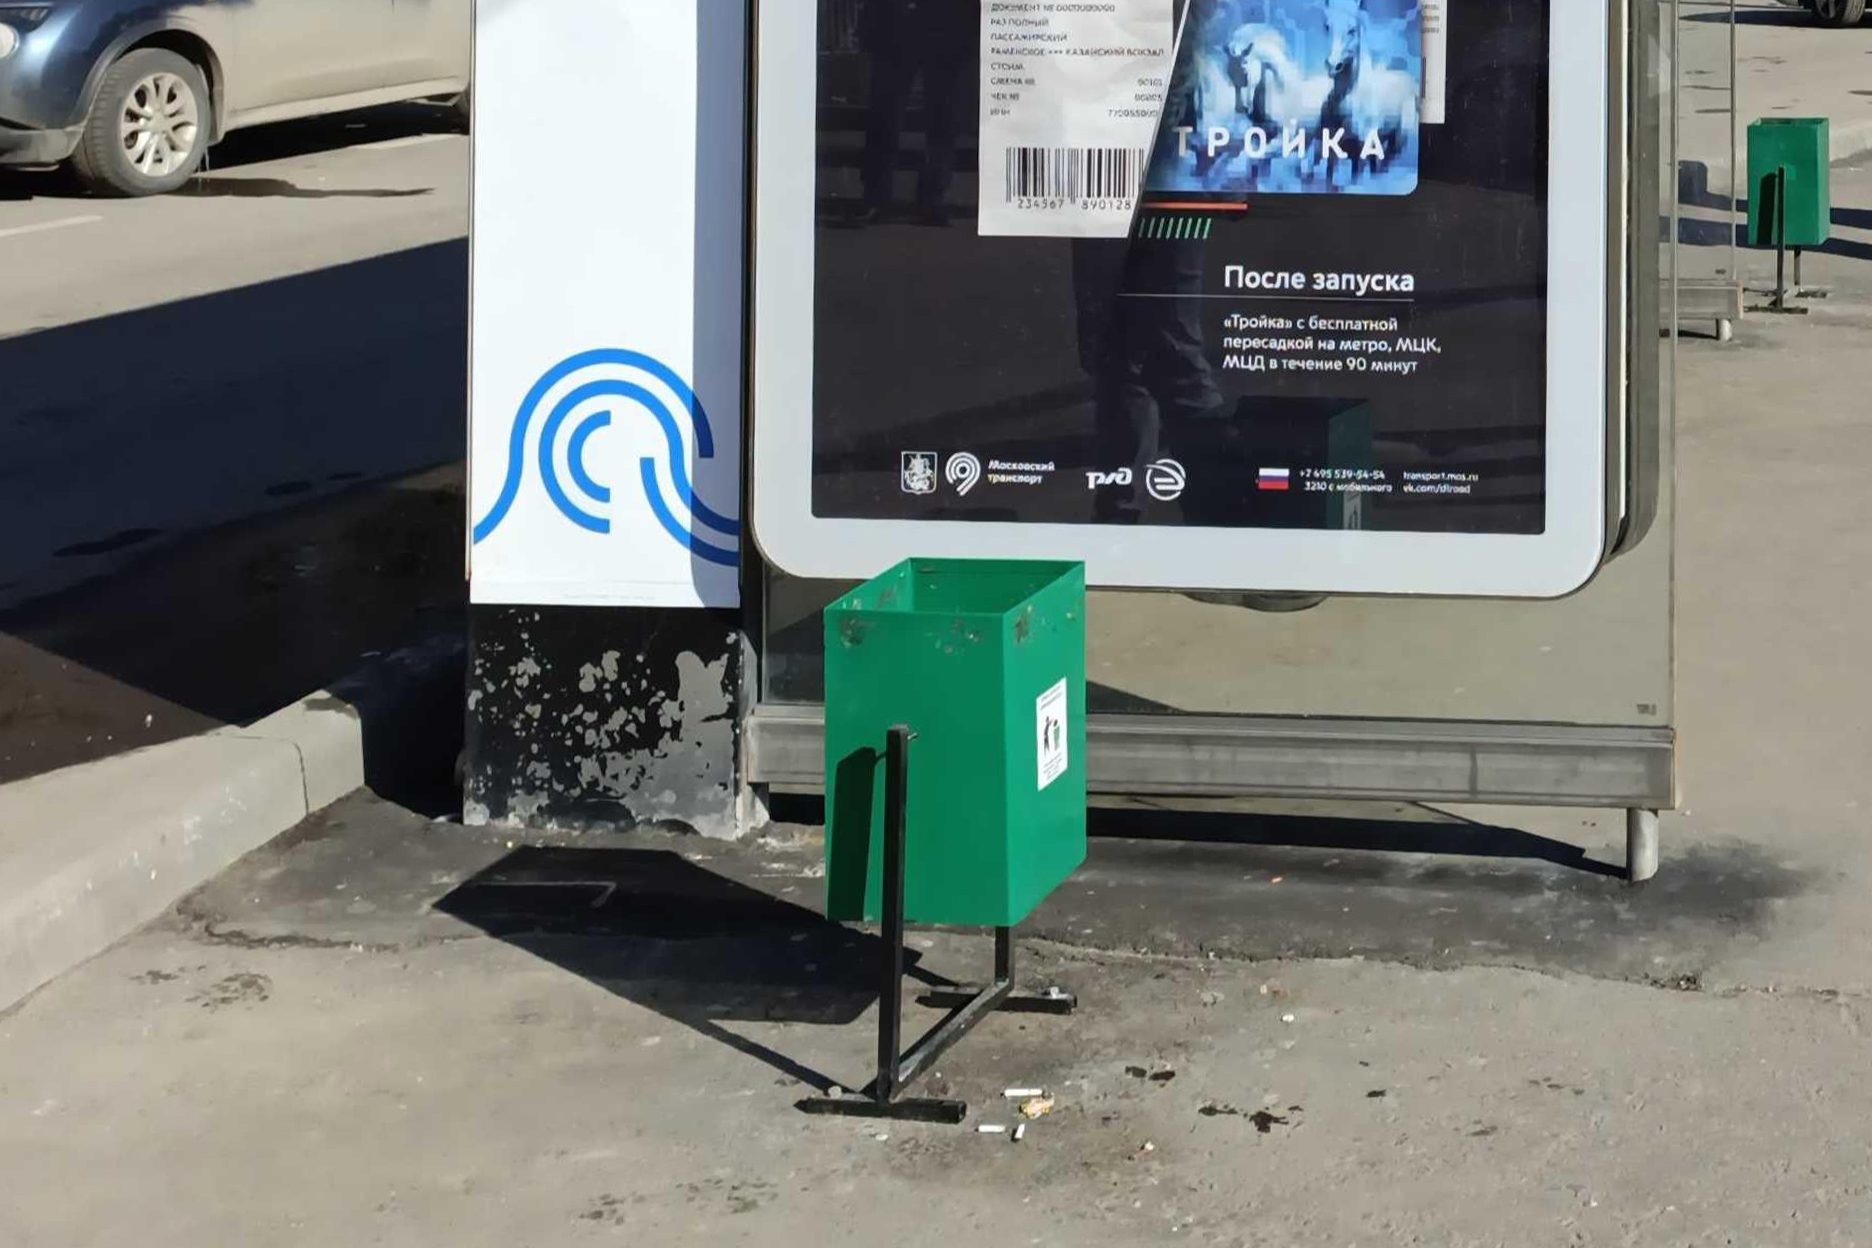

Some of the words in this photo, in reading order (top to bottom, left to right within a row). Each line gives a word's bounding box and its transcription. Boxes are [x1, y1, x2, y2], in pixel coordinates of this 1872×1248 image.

[1172, 118, 1385, 160] ТРОЙКА
[1017, 199, 1064, 209] 234567
[1224, 265, 1305, 289] После
[1313, 272, 1414, 296] запуска
[1224, 314, 1292, 331] «Тройка»
[1296, 319, 1305, 329] с
[1309, 315, 1398, 331] бесплатной
[1223, 336, 1313, 352] пересадкой
[1318, 340, 1335, 350] на
[1339, 340, 1391, 354] метро,
[1395, 338, 1441, 354] МЦК,
[1222, 355, 1265, 371] МЦД
[1269, 360, 1277, 369] в
[1282, 360, 1343, 370] течение
[1346, 357, 1366, 370] 90
[1371, 361, 1418, 374] минут
[988, 459, 1055, 472] Московский
[987, 473, 1042, 485] транспорт
[1313, 469, 1332, 479] 495
[1403, 471, 1479, 482] transport.mos.ru
